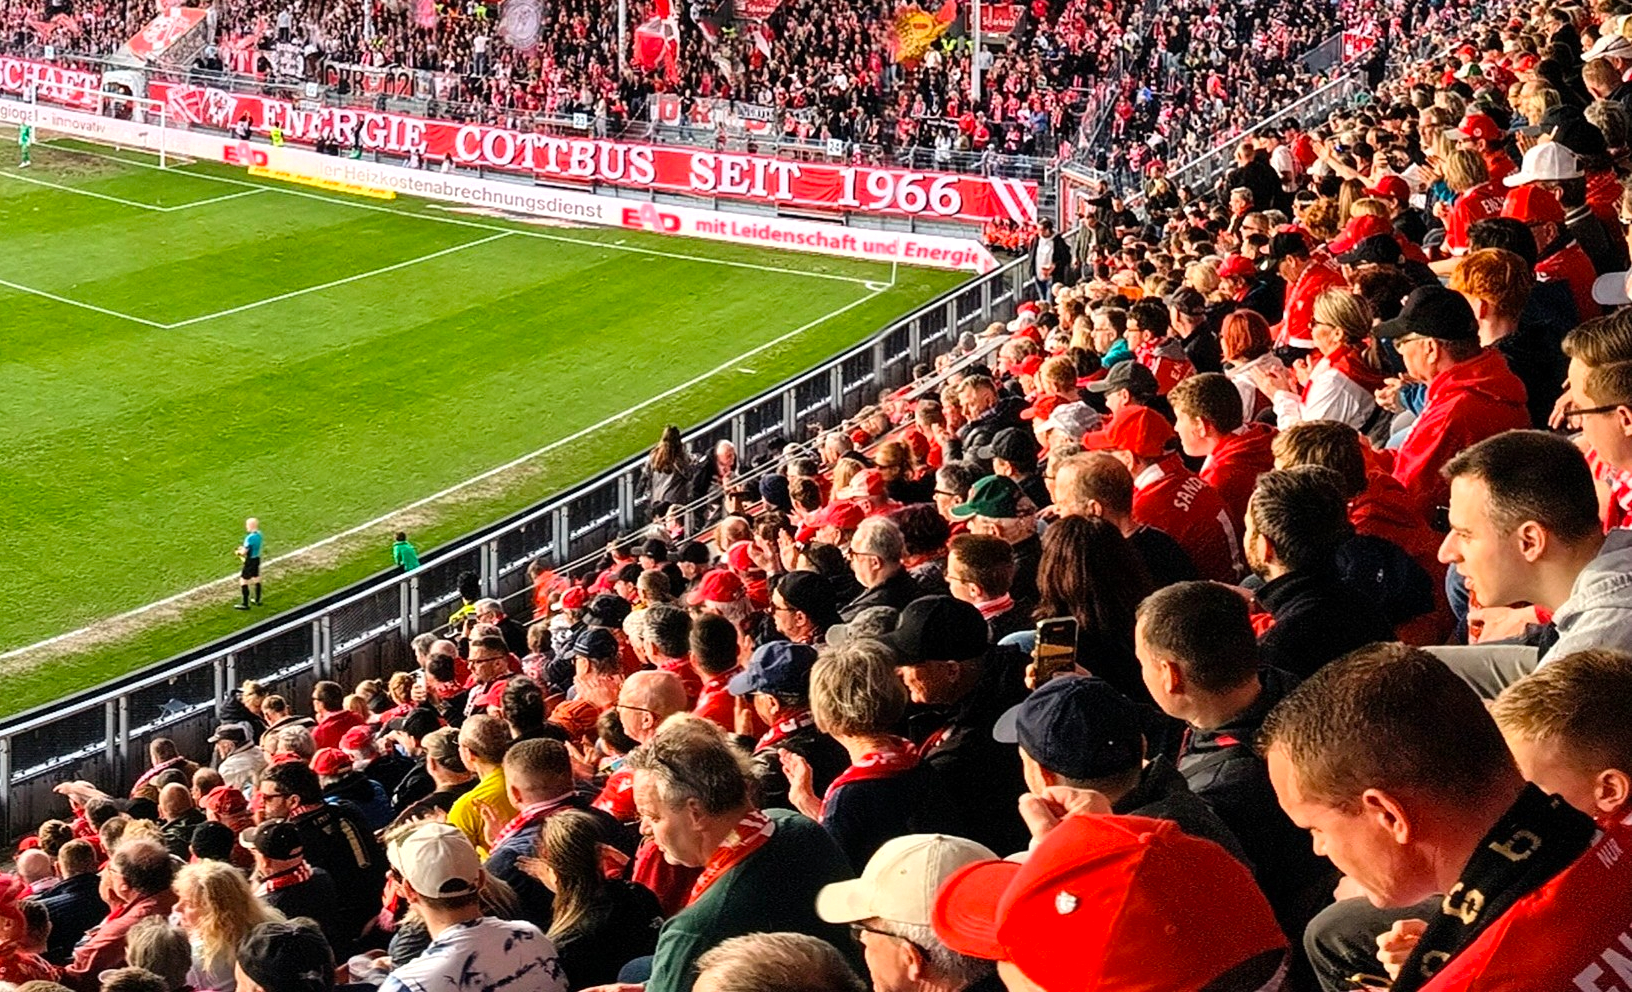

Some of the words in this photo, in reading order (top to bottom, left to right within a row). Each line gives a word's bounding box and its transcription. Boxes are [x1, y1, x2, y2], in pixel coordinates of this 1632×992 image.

[52, 112, 106, 133] innovativ
[575, 115, 585, 127] 23
[260, 98, 428, 155] ENERGIE
[454, 125, 657, 184] COTTBUS
[689, 150, 802, 201] SEIT
[838, 167, 963, 216] 1966
[343, 163, 603, 220] Heizkostenabrechnungsdienst
[695, 215, 729, 235] mit
[731, 218, 858, 253] Leidenschaft
[862, 236, 898, 255] und
[1596, 838, 1622, 870] NUR
